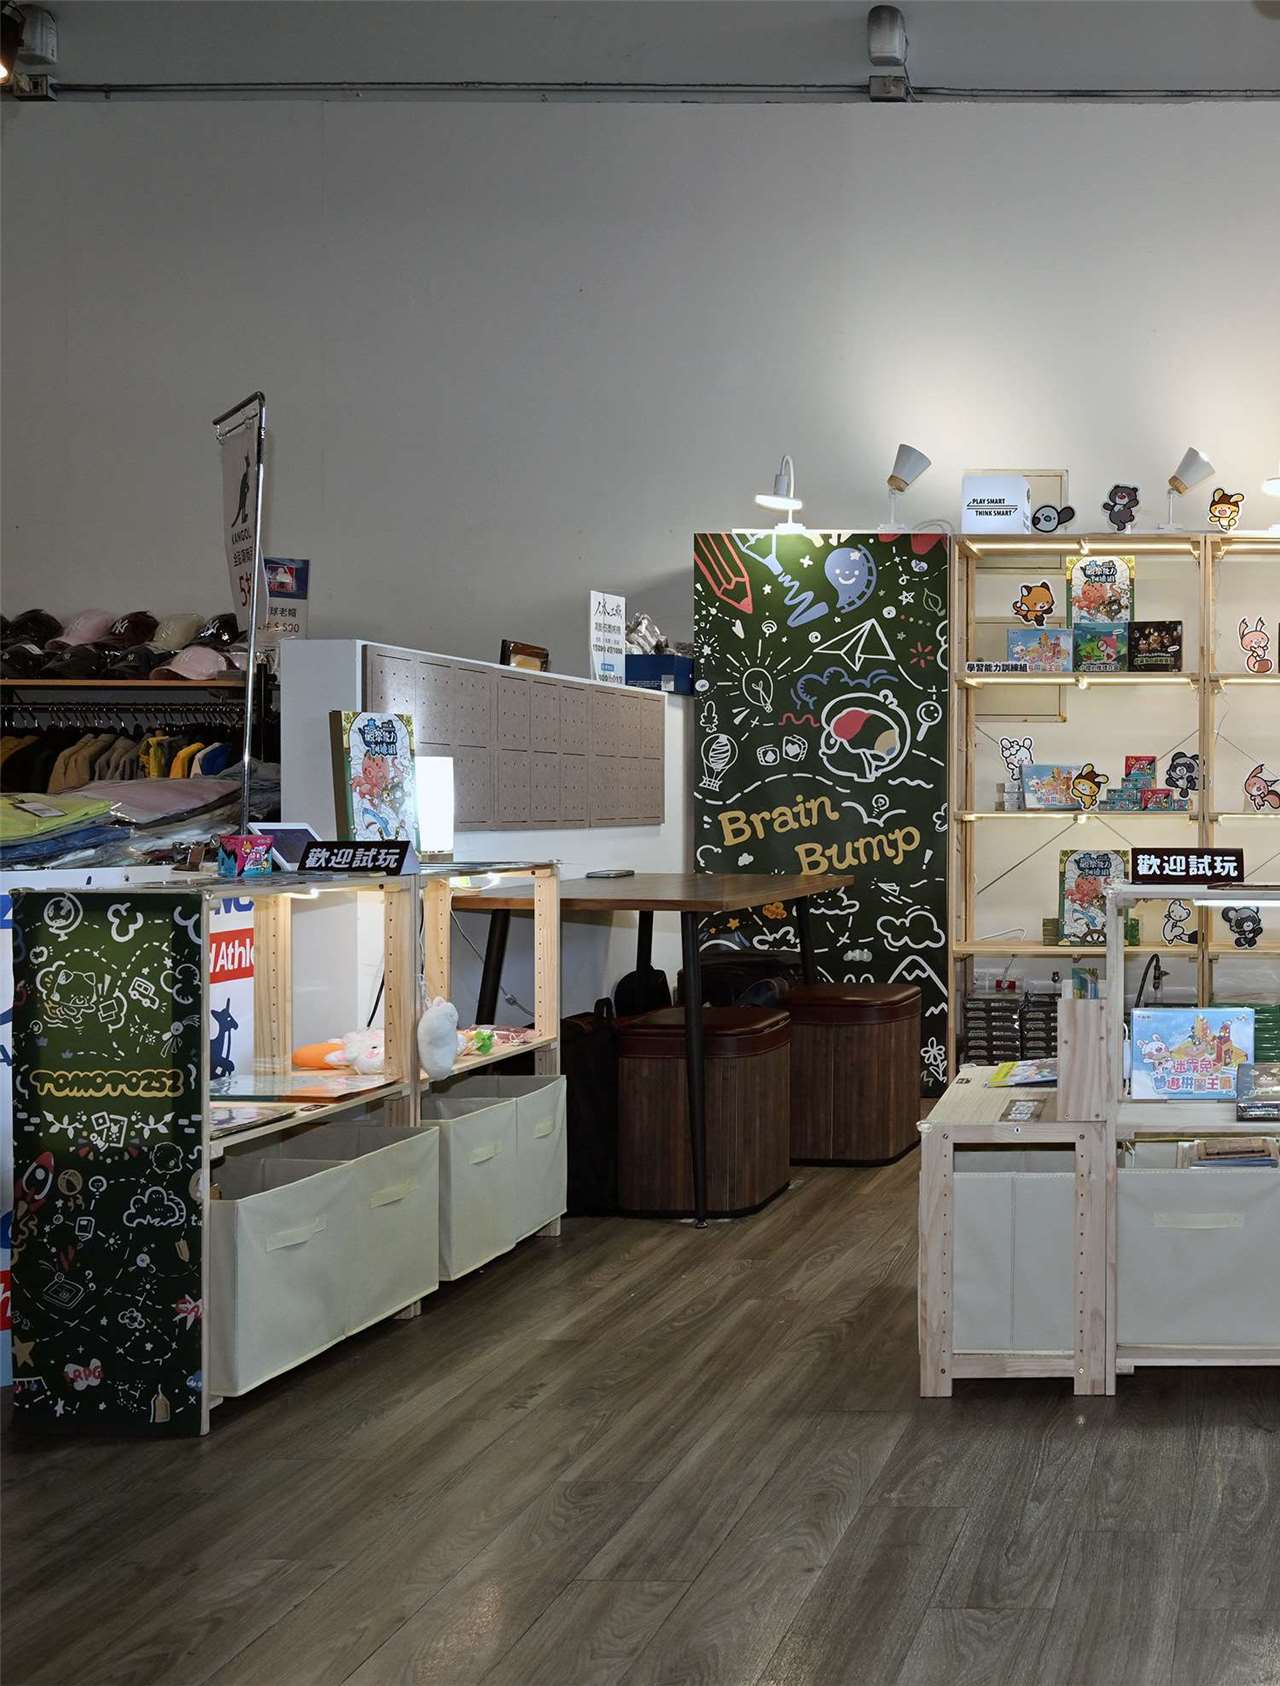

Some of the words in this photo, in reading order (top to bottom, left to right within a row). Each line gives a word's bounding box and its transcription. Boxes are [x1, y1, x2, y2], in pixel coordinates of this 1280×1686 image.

[966, 663, 1028, 672] 學習能力訓練組
[718, 794, 840, 846] Brain
[305, 848, 400, 868] 歡迎試玩
[794, 826, 921, 875] Bump
[1137, 854, 1239, 876] 歡迎試玩
